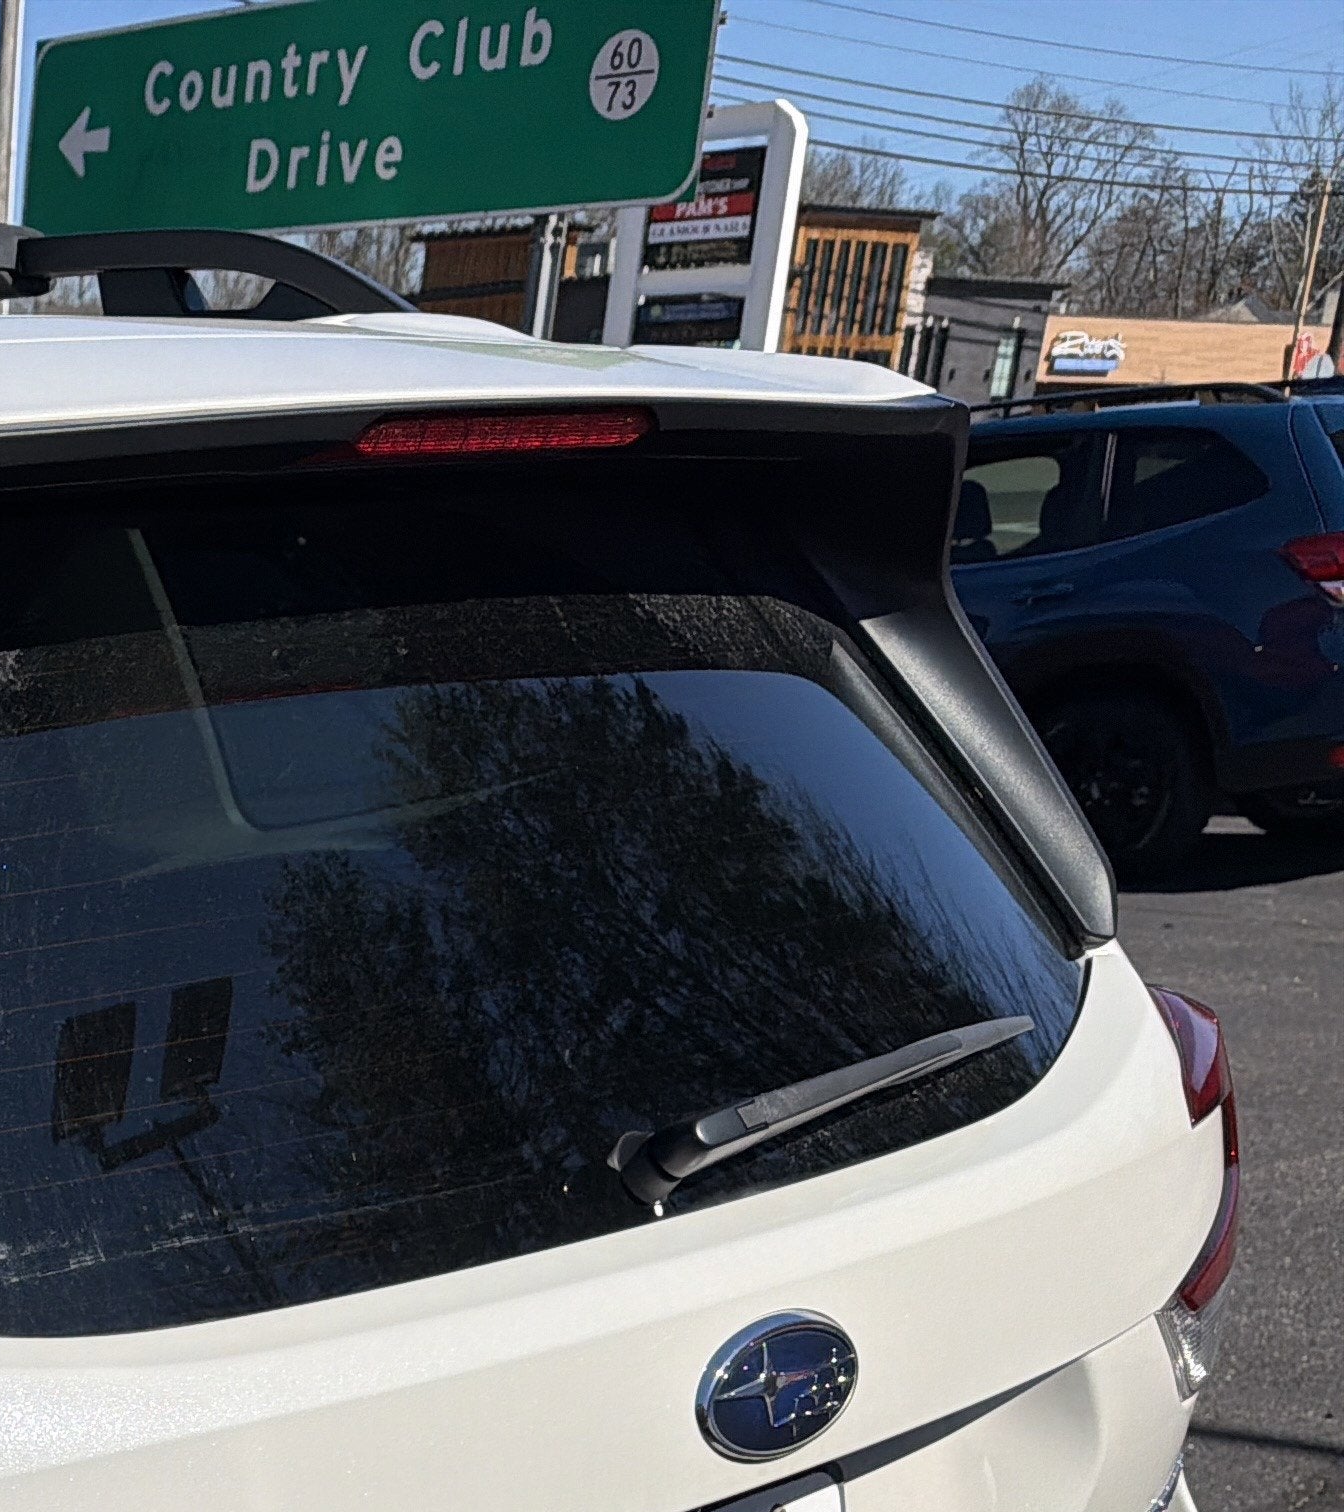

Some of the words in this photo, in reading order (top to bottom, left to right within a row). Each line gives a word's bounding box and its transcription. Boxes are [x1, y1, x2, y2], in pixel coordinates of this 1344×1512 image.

[144, 43, 368, 116] Country
[409, 7, 553, 80] Club
[610, 37, 643, 70] 60
[607, 80, 637, 112] 73
[245, 130, 404, 193] Drive
